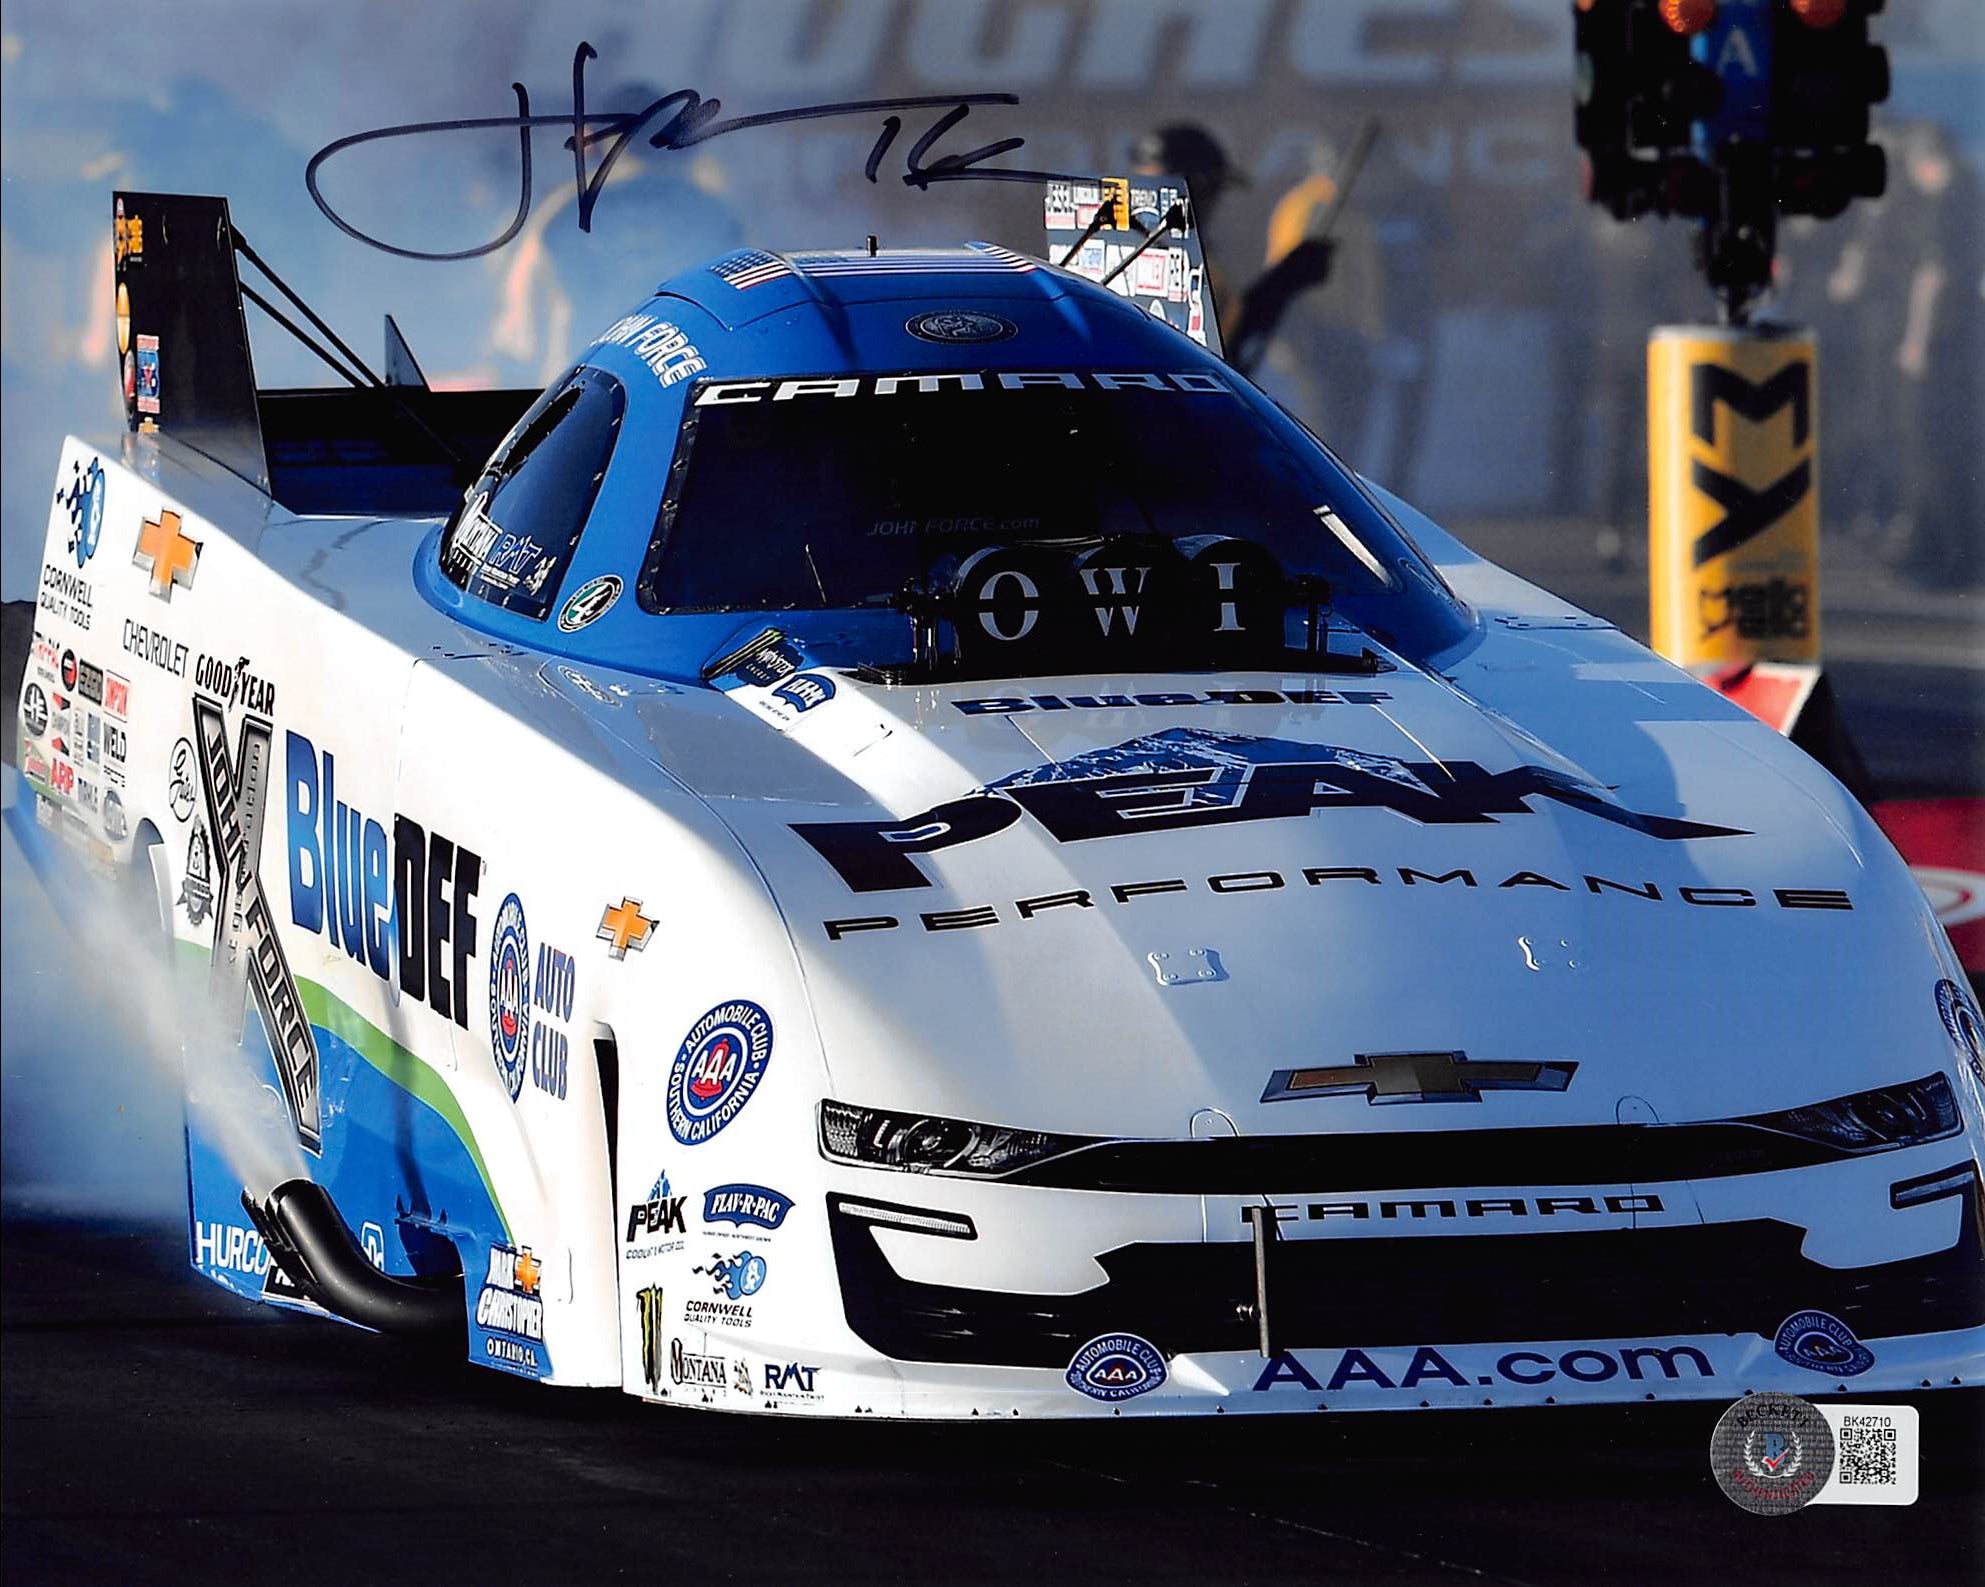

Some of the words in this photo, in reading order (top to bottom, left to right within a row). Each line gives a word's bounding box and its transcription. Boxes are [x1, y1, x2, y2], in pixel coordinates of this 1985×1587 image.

[624, 321, 708, 389] FORCE
[694, 372, 1231, 406] CAMARO
[43, 563, 93, 608] CORNWELL
[40, 591, 69, 618] QUALITY
[70, 603, 91, 631] TOOLS
[122, 617, 189, 679] CHEVROLET
[195, 653, 276, 717] GOODYEAR
[787, 760, 1757, 894] PEAK
[822, 866, 1855, 941] PERFORMANCE
[246, 896, 313, 1109] FORCE
[533, 941, 576, 1024] AUTO
[684, 1005, 760, 1054] AUTOMOBILE
[750, 1022, 769, 1062] CLUB
[532, 1020, 569, 1101] CLUB
[691, 1049, 738, 1086] AAA
[669, 1062, 694, 1140] SOUTHERN
[690, 1071, 761, 1141] CALIFORNIA
[626, 1195, 688, 1242] PEAK
[195, 1221, 271, 1276] HURCO
[684, 1313, 717, 1325] QUALITY
[721, 1317, 752, 1329] TOOLS
[685, 1299, 753, 1319] CORNWELL
[764, 1362, 822, 1392] RMT
[1075, 1339, 1141, 1372] AUTOMOBILE
[1094, 1367, 1138, 1382] AAA
[1252, 1345, 1716, 1392] AAA.com
[1843, 1416, 1891, 1428] BK42710
